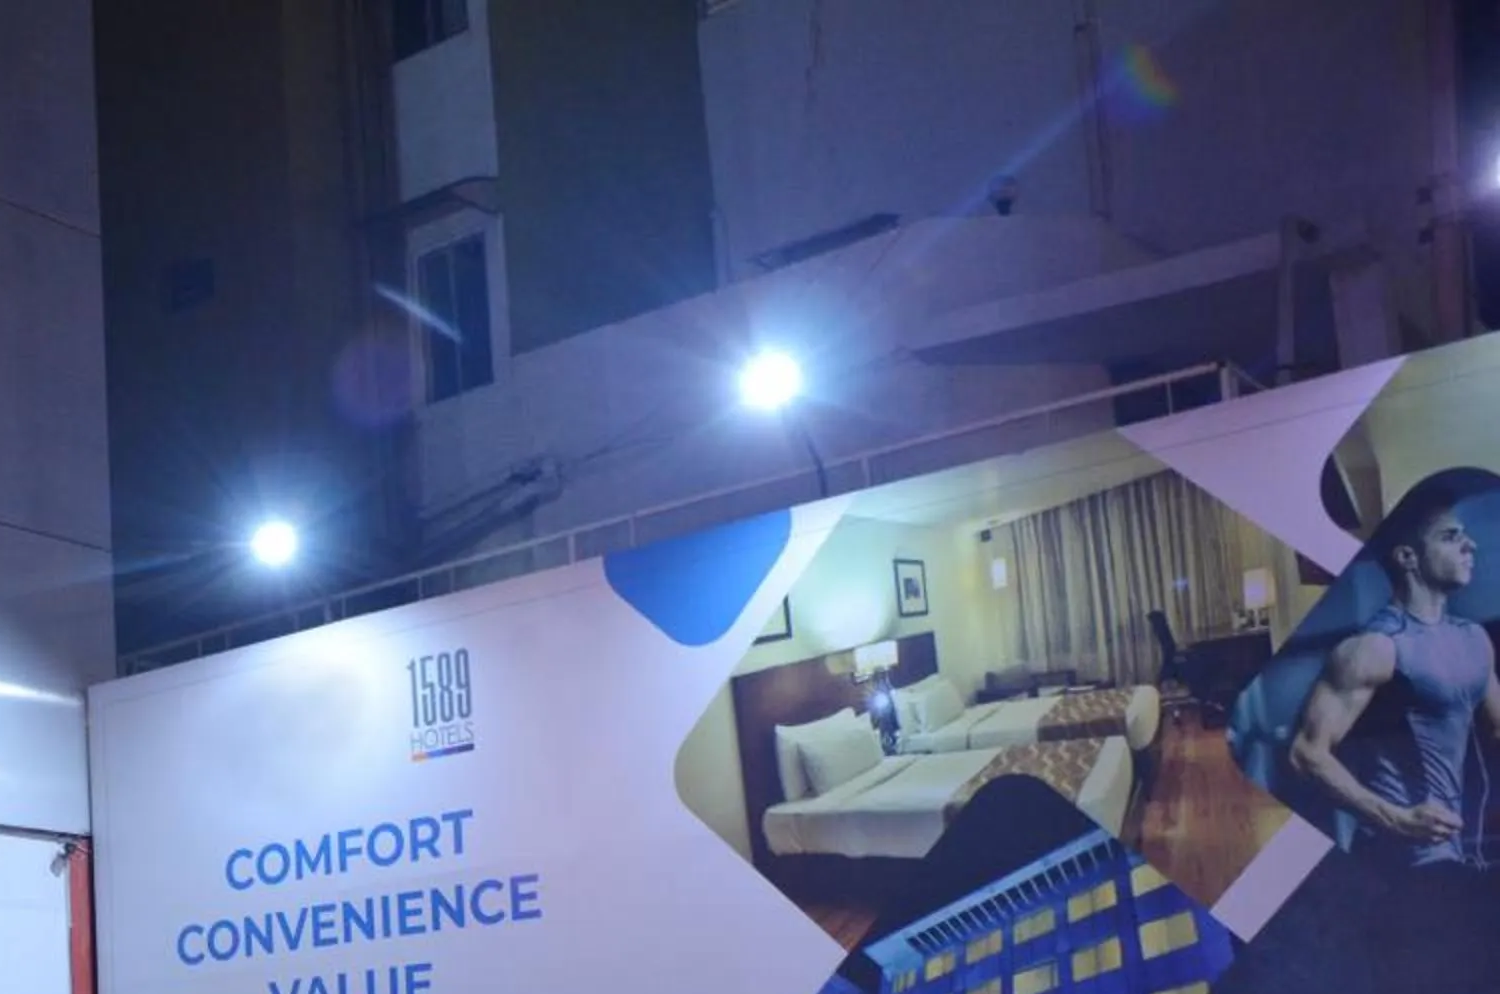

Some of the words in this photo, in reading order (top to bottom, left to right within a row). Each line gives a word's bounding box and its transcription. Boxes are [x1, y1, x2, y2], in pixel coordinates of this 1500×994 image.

[406, 647, 472, 728] 1589
[410, 720, 475, 753] HOTELS
[225, 809, 473, 890] COMFORT
[176, 874, 542, 965] CONVENIENCE
